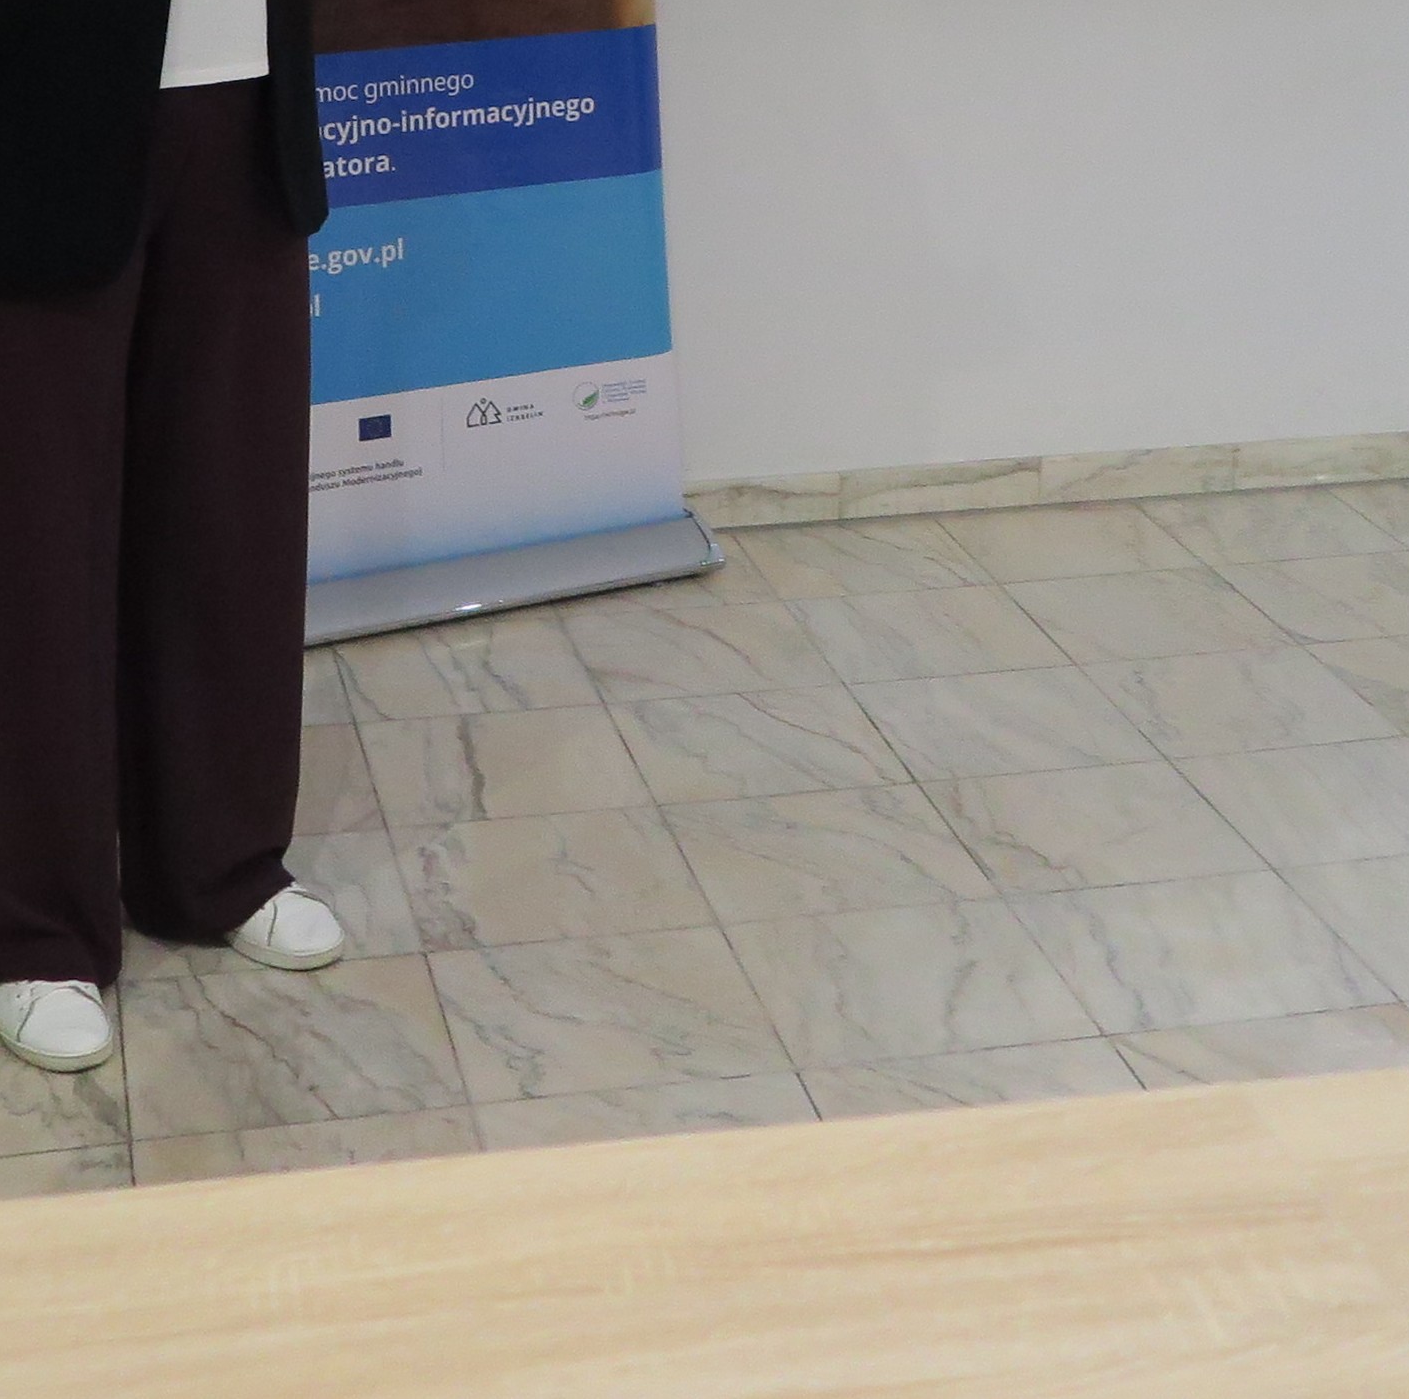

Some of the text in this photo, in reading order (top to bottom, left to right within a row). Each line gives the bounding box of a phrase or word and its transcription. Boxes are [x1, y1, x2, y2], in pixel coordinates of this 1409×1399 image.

[315, 73, 474, 104] moc gminnego
[319, 97, 595, 145] cyjno-informacyjnego
[323, 154, 396, 179] atora.
[308, 237, 405, 274] e.gov.pl
